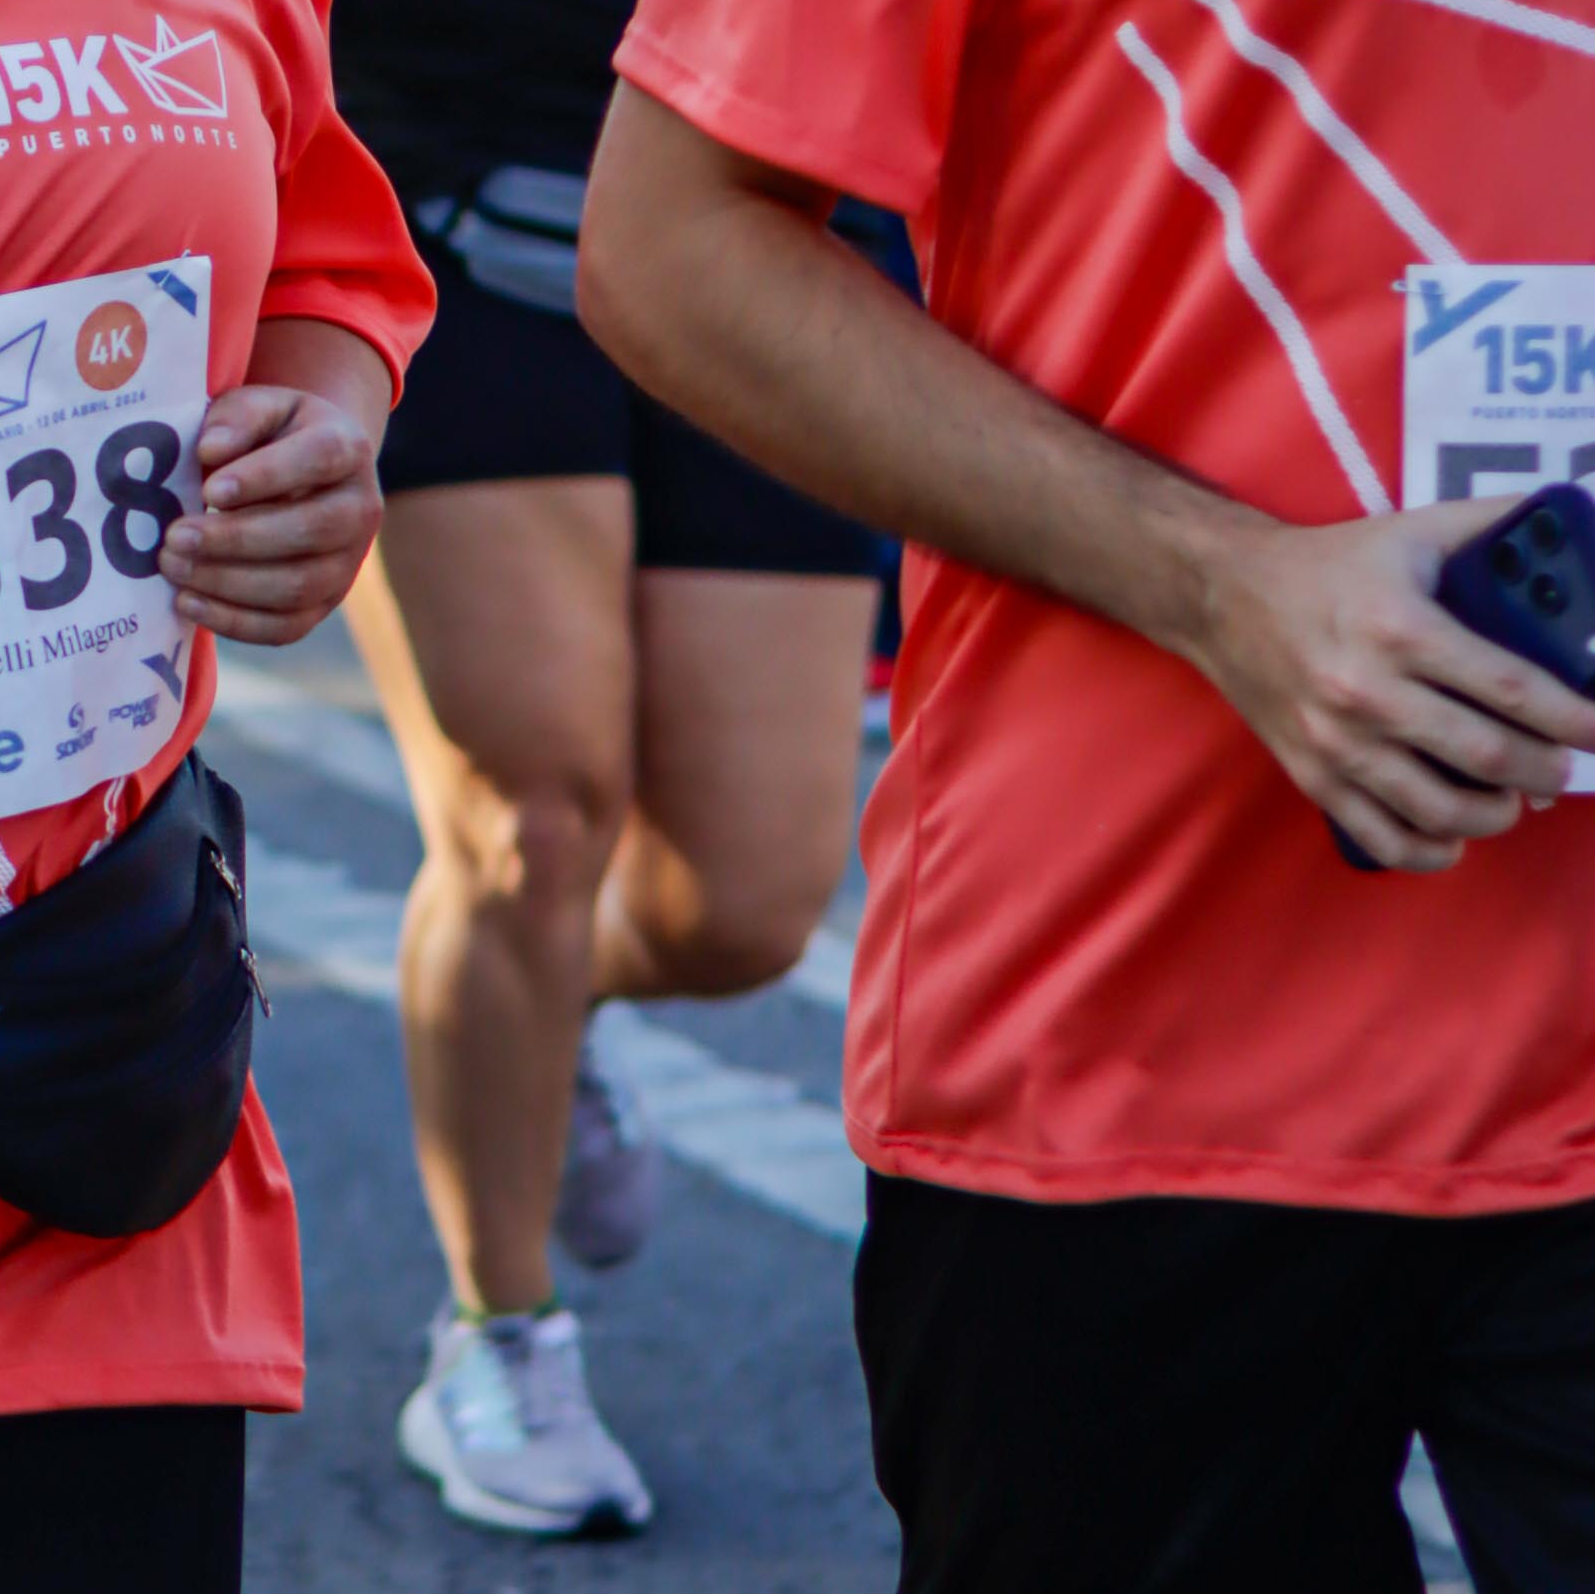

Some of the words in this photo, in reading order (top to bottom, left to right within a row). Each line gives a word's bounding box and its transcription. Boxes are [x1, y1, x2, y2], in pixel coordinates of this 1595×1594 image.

[149, 123, 238, 150] NORTE
[88, 325, 133, 366] 4K
[40, 613, 139, 664] Milagros
